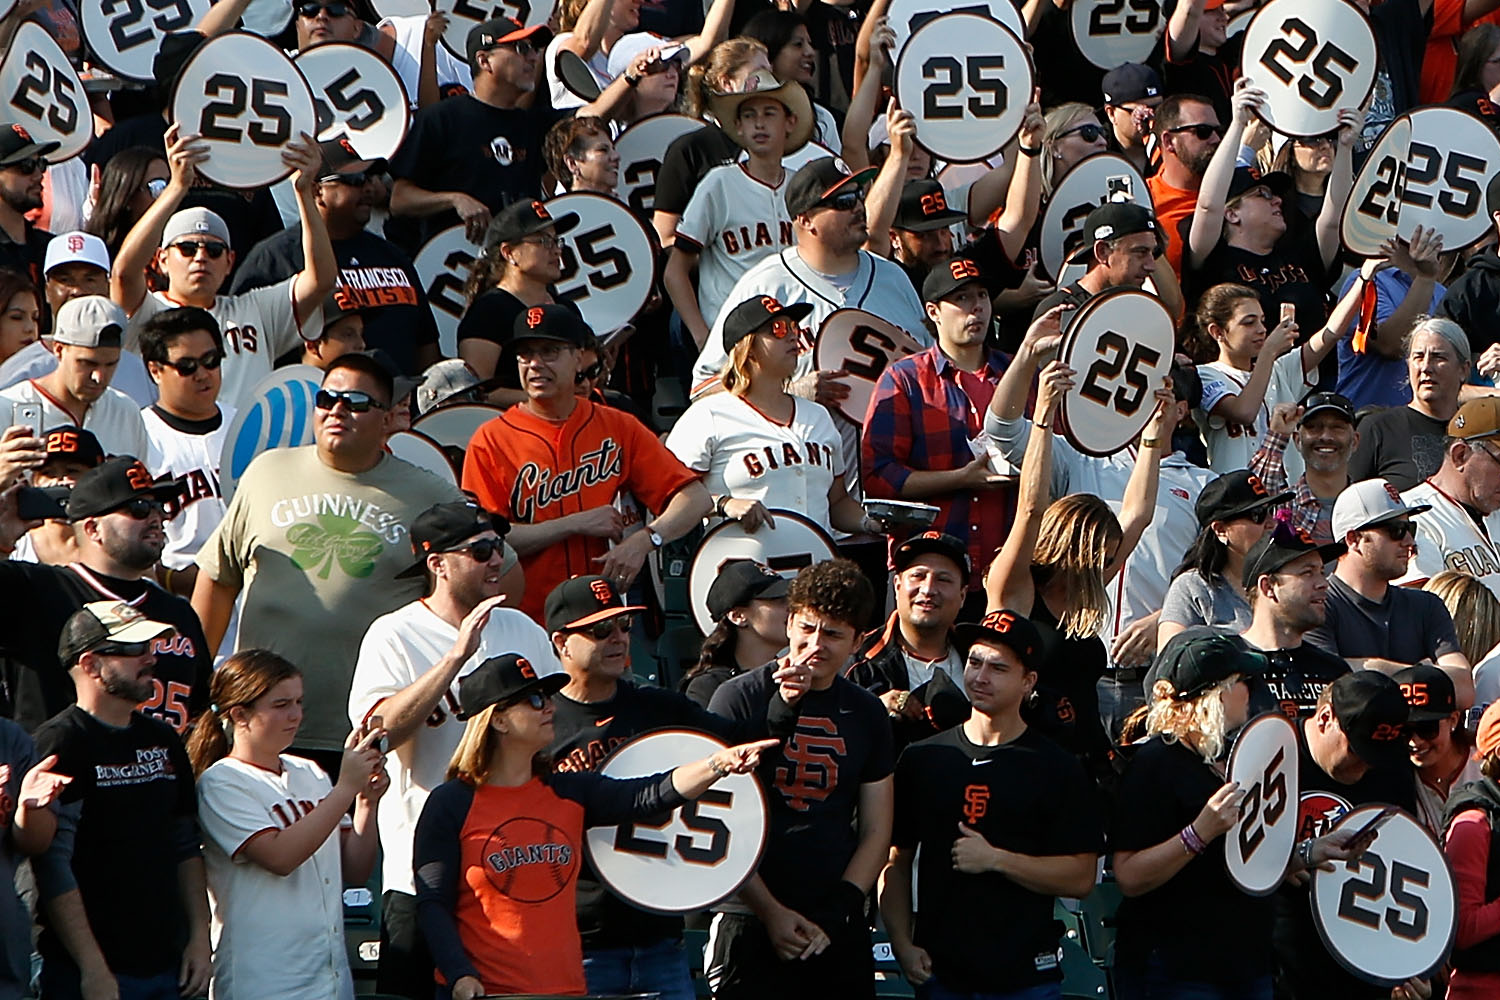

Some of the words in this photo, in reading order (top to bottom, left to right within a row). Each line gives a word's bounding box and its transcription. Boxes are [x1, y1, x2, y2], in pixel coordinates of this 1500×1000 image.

[1260, 17, 1359, 109] 25
[13, 49, 79, 136] 25
[922, 55, 1008, 119] 25
[200, 73, 292, 146] 25
[1403, 141, 1487, 218] 25
[920, 192, 947, 214] 25
[722, 221, 794, 256] GIAN
[341, 267, 411, 289] FRANCISCO
[950, 260, 979, 281] 25
[526, 306, 544, 328] SF
[1080, 331, 1159, 415] 25
[46, 432, 78, 452] 25
[743, 443, 833, 479] GIANT
[510, 440, 625, 524] Giants
[270, 492, 408, 550] GUINNESS
[591, 580, 613, 604] SF
[980, 613, 1016, 635] 25
[1267, 682, 1330, 703] RANCISC
[1371, 721, 1401, 742] 25
[772, 714, 848, 812] SF
[962, 783, 991, 825] SF
[1237, 747, 1287, 863] 25
[614, 787, 733, 866] 25
[487, 843, 572, 877] GIANTS
[1337, 850, 1430, 942] 25
[368, 944, 378, 957] 6
[881, 944, 891, 958] 9
